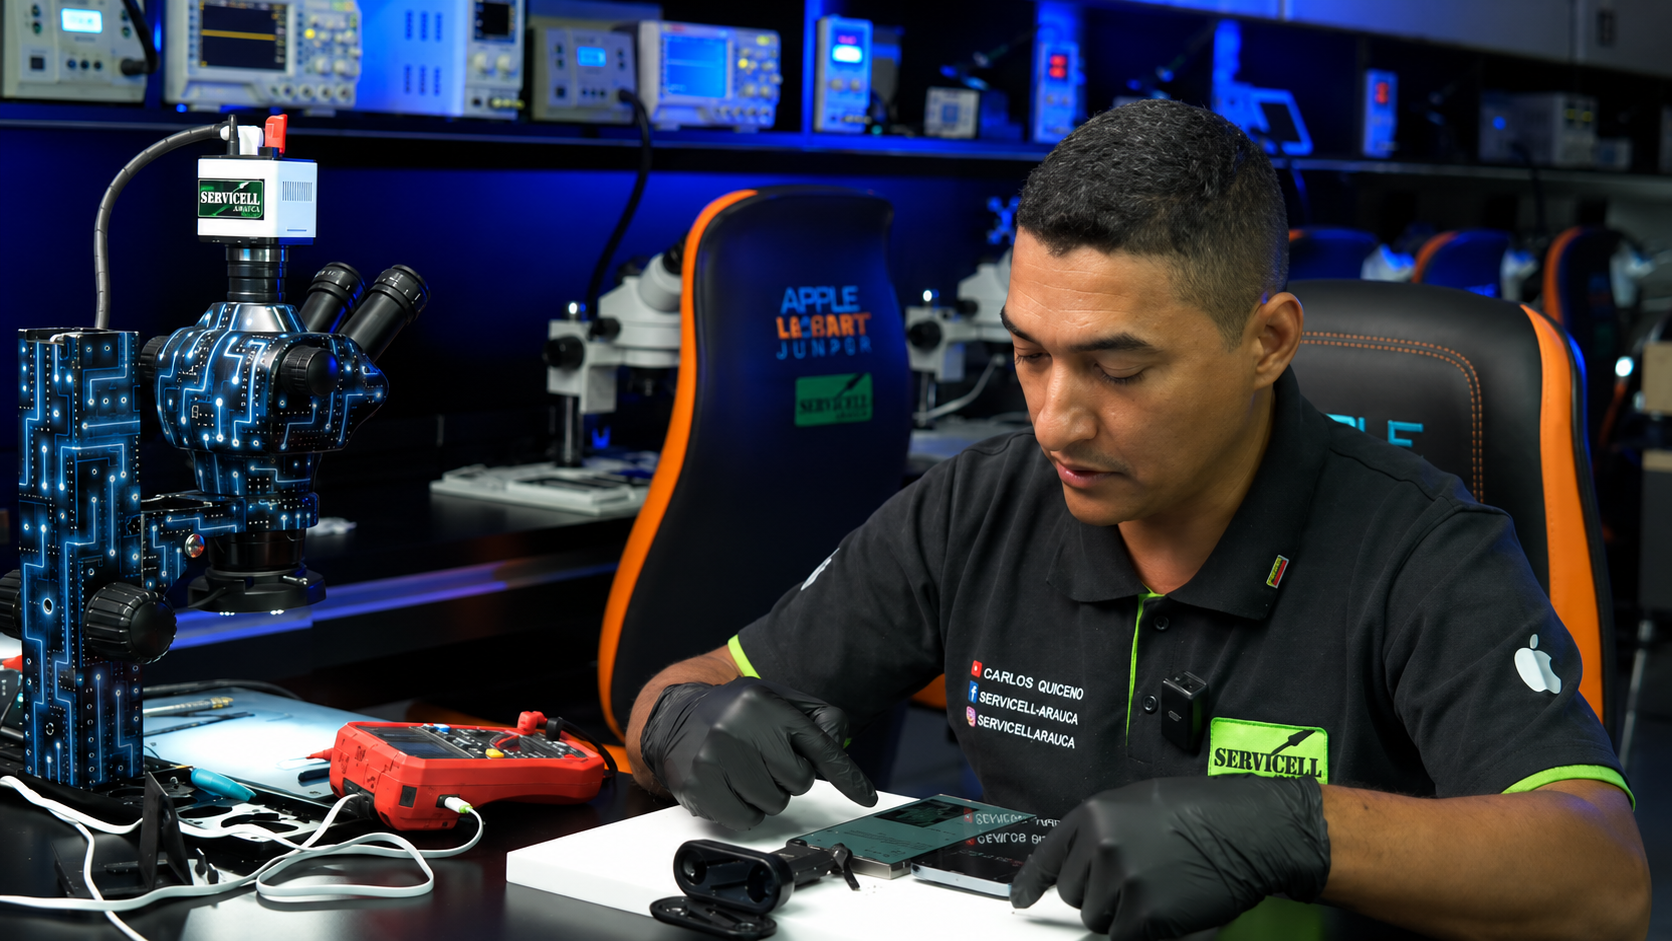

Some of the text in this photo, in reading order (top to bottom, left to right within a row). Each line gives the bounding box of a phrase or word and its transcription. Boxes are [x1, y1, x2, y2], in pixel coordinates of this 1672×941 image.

[200, 191, 260, 205] SERVICELL
[780, 285, 861, 315] APPLE
[983, 667, 1084, 700] CARLOS QUICENO
[979, 691, 1078, 725] SERVICELL-ARAUCA
[977, 714, 1075, 749] SERVICELLARAUCA
[1214, 747, 1322, 778] SERVICELL
